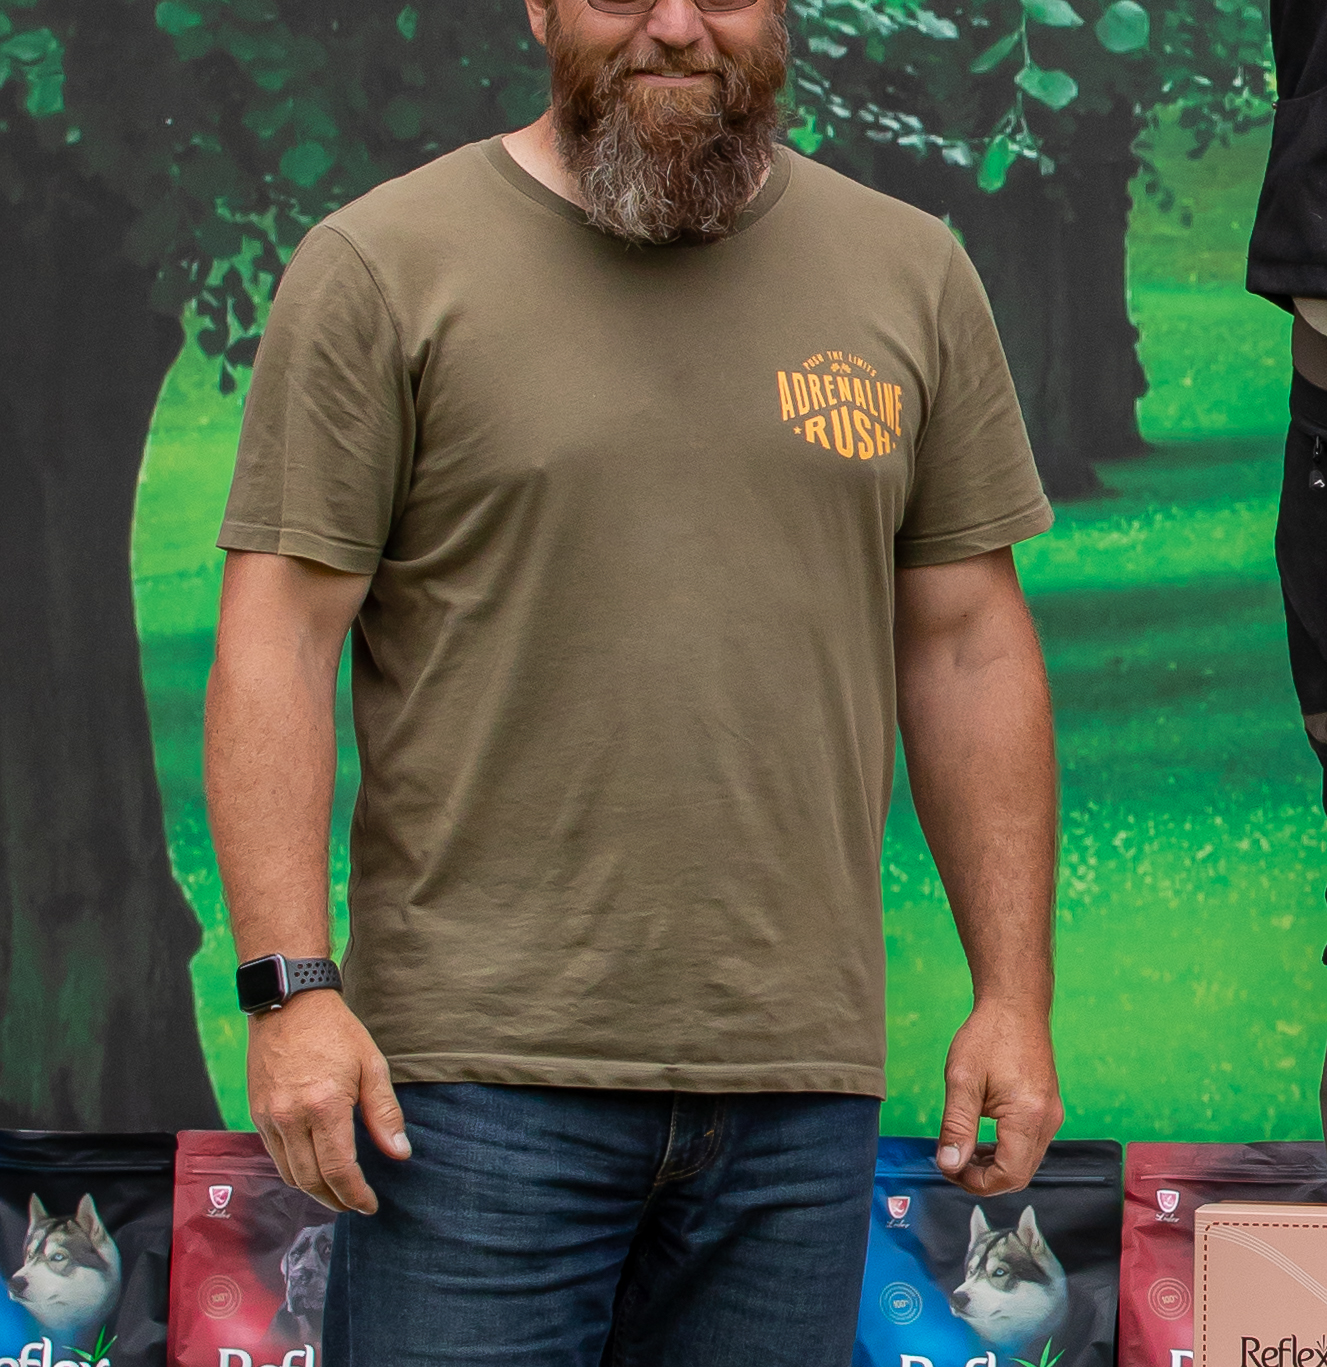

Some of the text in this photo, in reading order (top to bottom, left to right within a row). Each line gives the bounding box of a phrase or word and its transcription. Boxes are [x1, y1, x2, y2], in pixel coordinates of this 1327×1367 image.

[802, 350, 878, 377] PUSH THE LIMITS
[777, 370, 902, 437] ADRENALINE
[804, 405, 891, 460] RUSH
